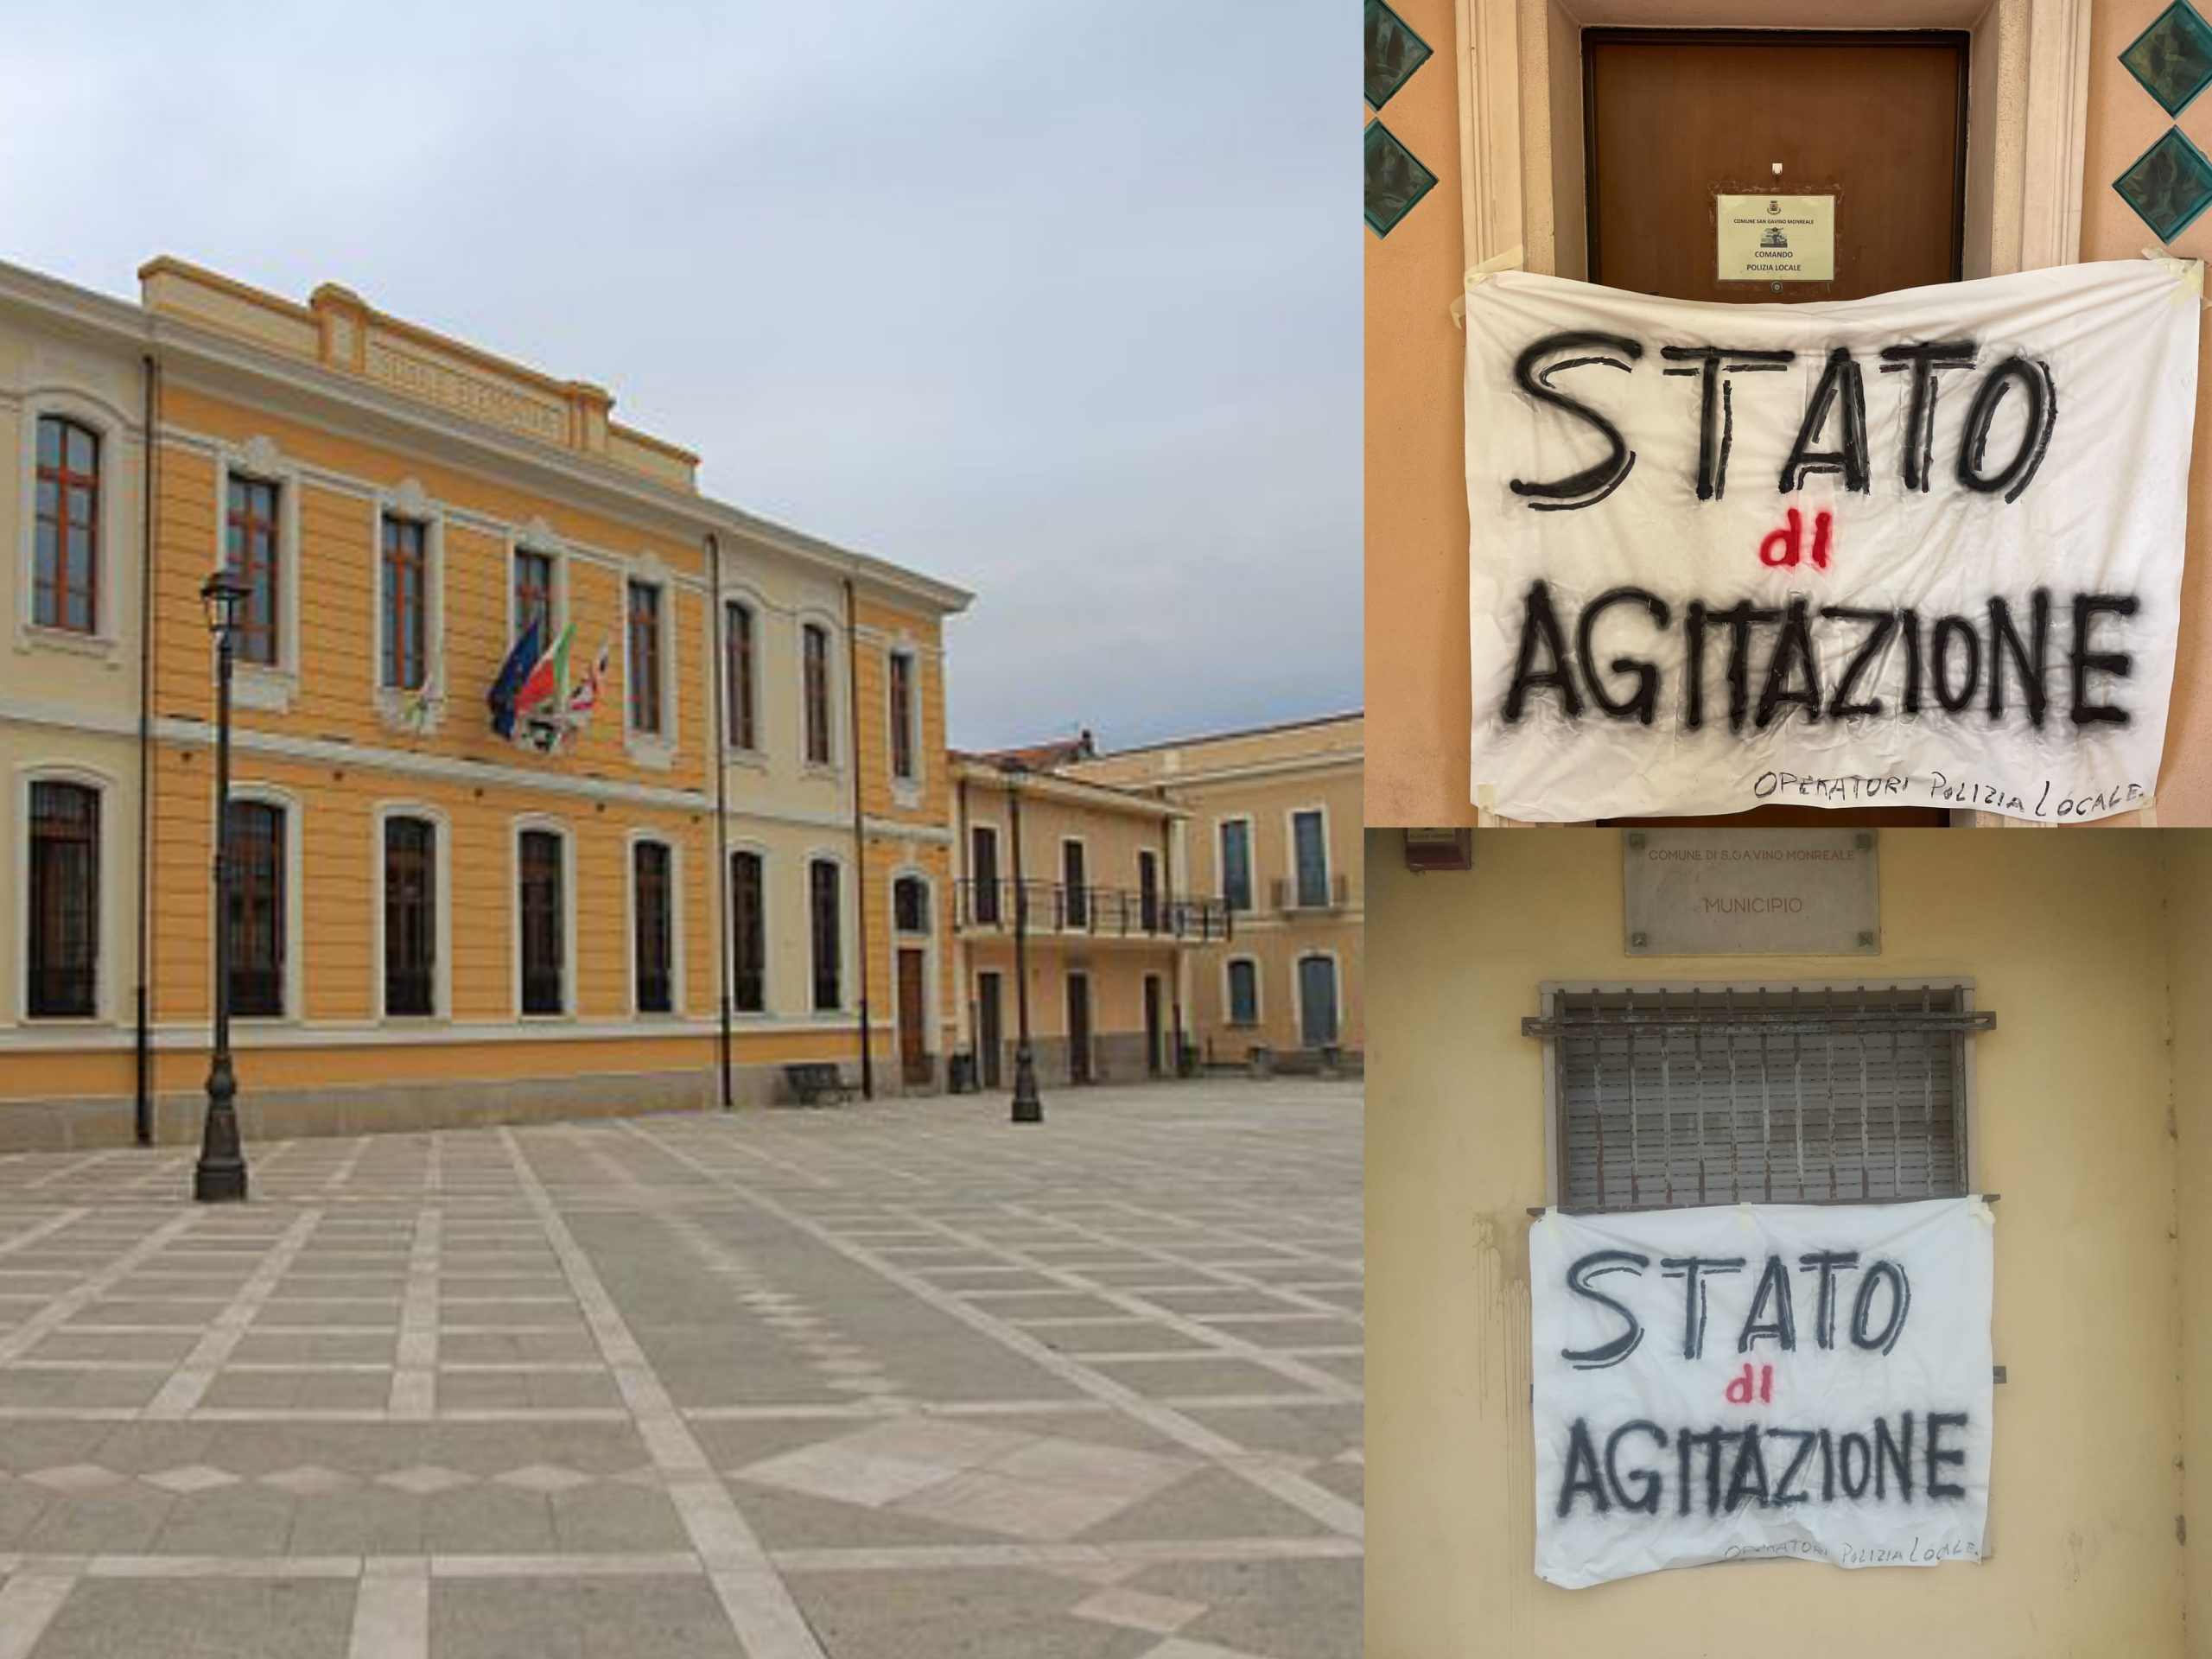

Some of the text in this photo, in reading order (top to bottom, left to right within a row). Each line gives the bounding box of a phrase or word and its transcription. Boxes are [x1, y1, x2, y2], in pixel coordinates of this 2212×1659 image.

[1509, 329, 2058, 512] STATO
[1499, 578, 2141, 733] AGITAZIONE
[1753, 771, 1909, 802] OPERATORI
[1648, 849, 1702, 861] COMUNE
[1706, 849, 1718, 861] DI
[1786, 849, 1855, 861] MONREALE
[1705, 897, 1803, 914] MUNICIPIO
[1560, 1249, 1911, 1370] STATO
[1557, 1410, 1969, 1519] AGITAZIONE
